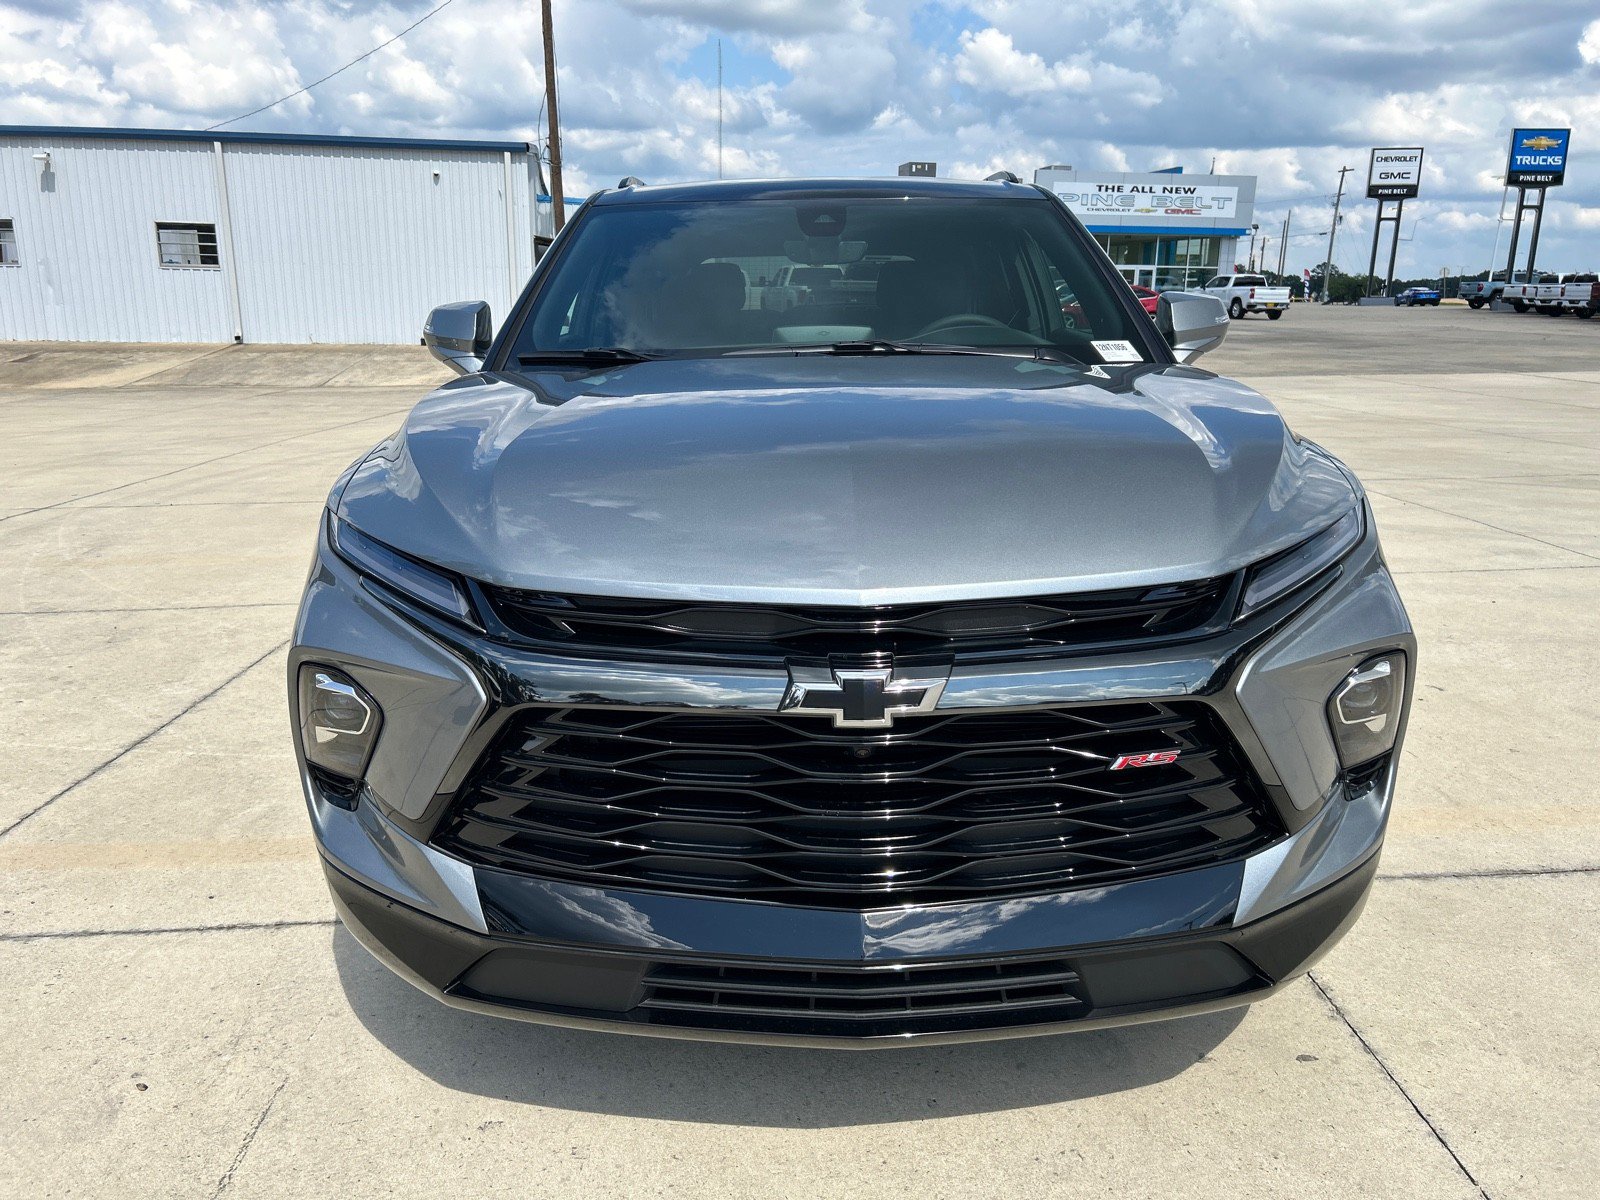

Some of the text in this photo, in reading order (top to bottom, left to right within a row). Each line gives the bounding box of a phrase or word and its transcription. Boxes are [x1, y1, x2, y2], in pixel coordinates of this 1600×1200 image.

[1376, 155, 1419, 163] CHEVROLET
[1515, 155, 1563, 166] TRUCKS
[1379, 172, 1412, 180] GMC
[1519, 174, 1536, 182] PINE
[1096, 184, 1197, 195] THE ALL NEW
[1057, 193, 1233, 210] PINE BELT
[1164, 208, 1202, 216] GMC
[1110, 750, 1181, 770] RS
